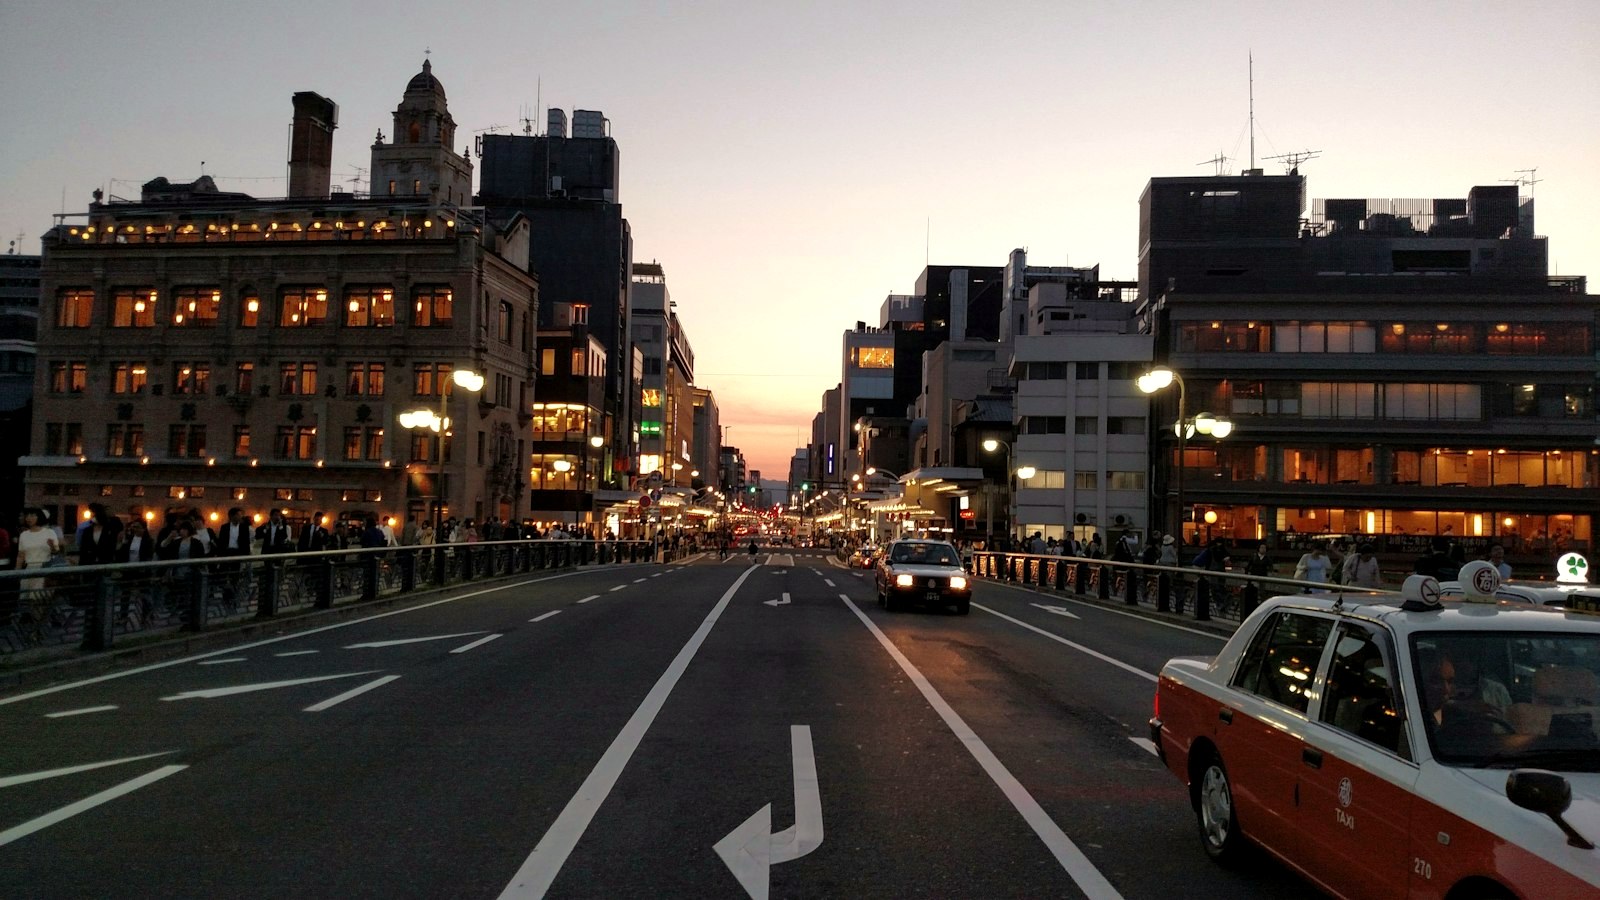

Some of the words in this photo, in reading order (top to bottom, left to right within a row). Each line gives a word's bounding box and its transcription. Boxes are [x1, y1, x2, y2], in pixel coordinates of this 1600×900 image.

[1478, 568, 1498, 592] 都
[1335, 807, 1354, 830] TAXI
[1414, 857, 1432, 880] 270
